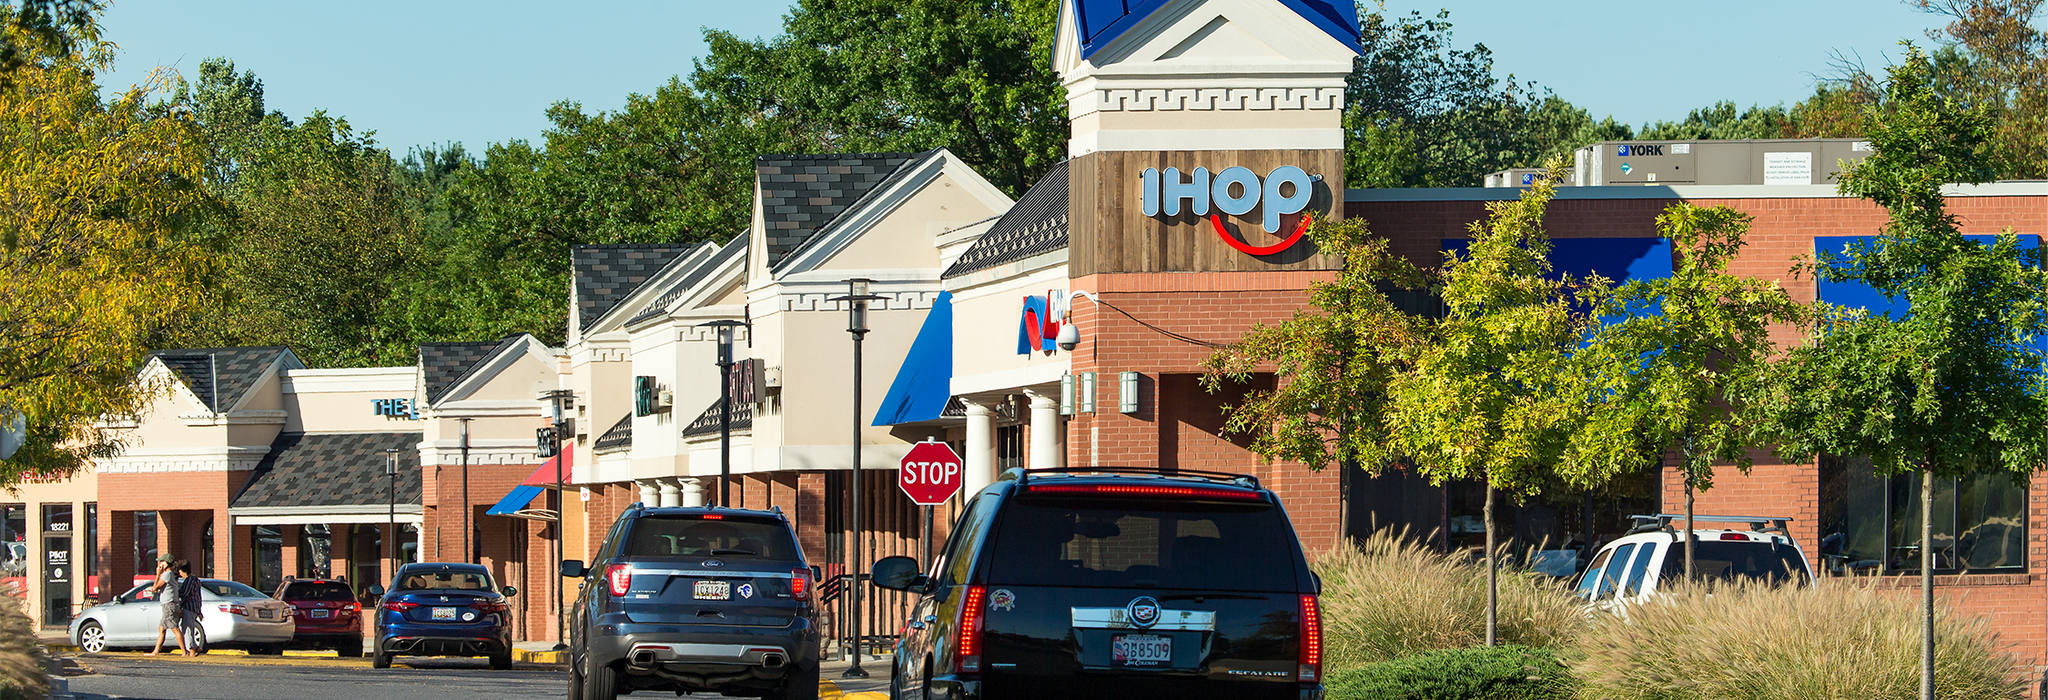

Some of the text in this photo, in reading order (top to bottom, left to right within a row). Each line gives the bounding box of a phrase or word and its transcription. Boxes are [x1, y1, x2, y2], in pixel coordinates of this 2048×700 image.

[1630, 145, 1663, 156] YORK
[1142, 165, 1312, 234] IHOP
[371, 398, 405, 416] THE
[904, 461, 958, 485] STOP
[50, 523, 69, 531] 18221
